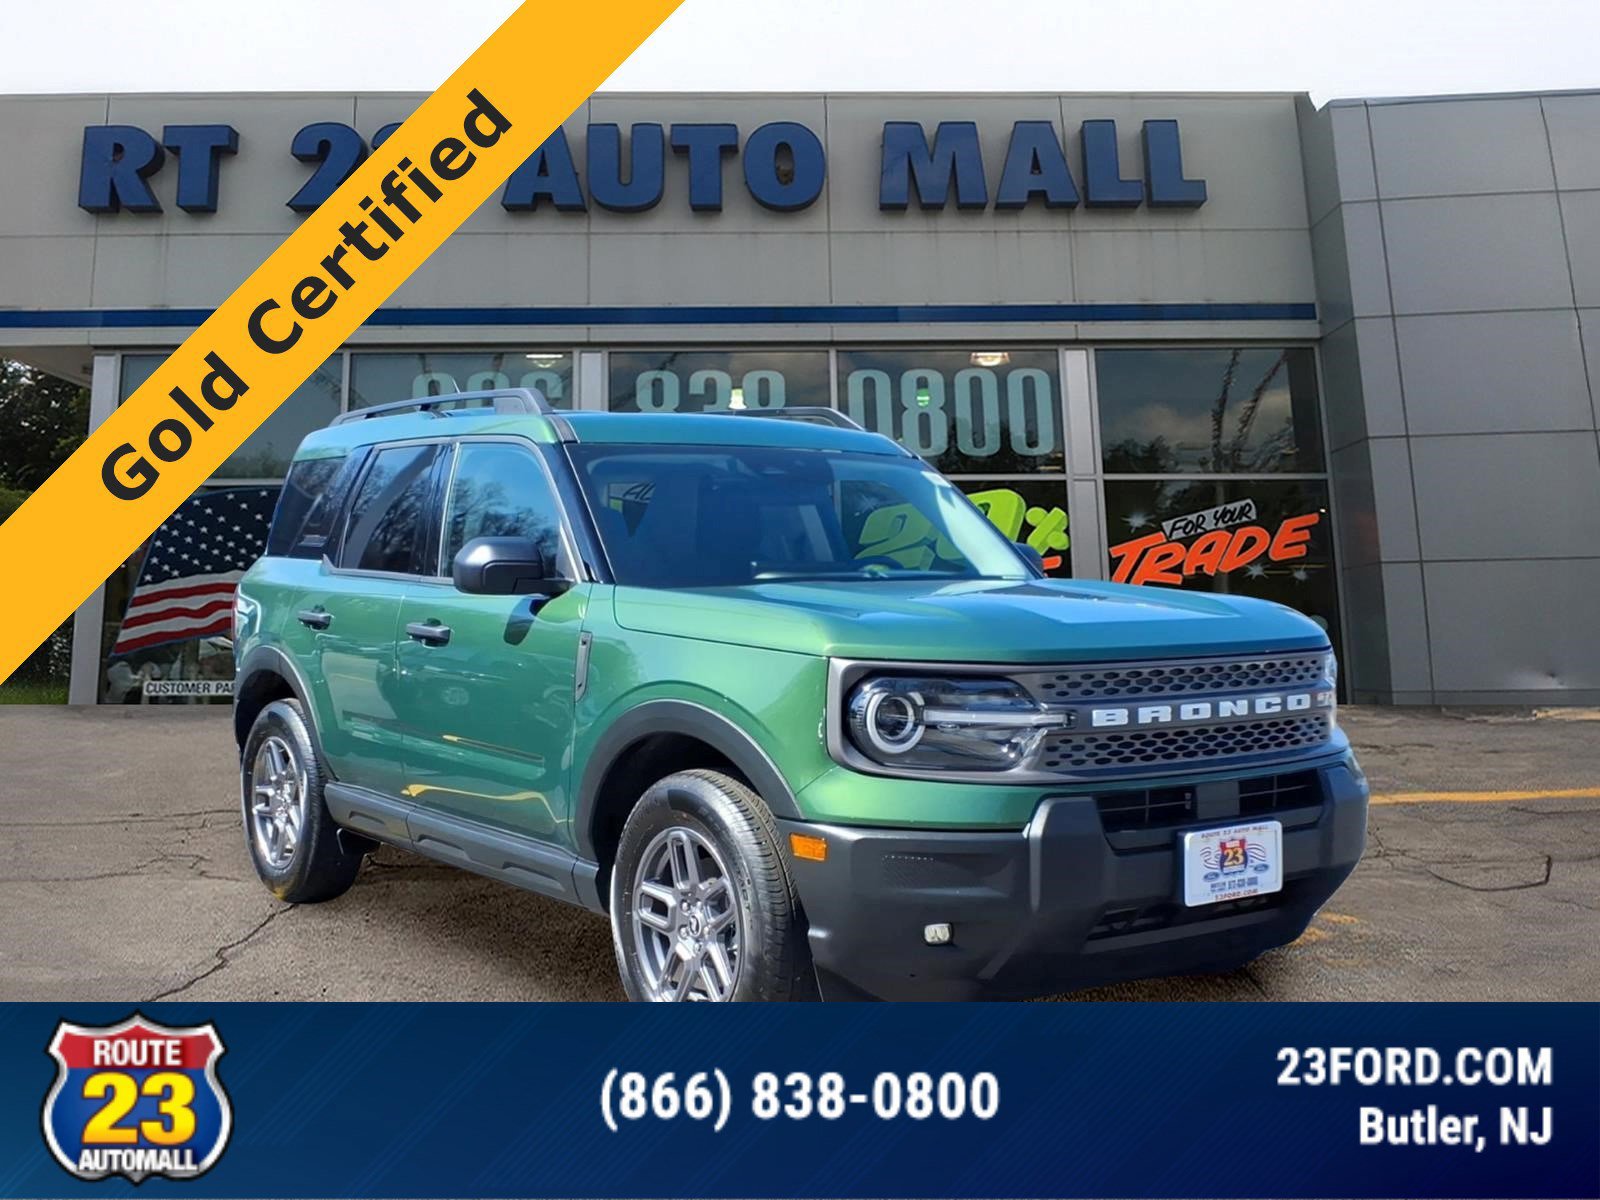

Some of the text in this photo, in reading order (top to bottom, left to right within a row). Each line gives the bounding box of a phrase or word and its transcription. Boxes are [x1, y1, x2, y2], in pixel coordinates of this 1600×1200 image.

[78, 119, 1207, 214] RT 2 AUTO MALL
[847, 368, 1054, 457] 0800
[1168, 502, 1252, 538] FOR YOUR
[1109, 512, 1320, 586] TRADE
[145, 682, 211, 694] CUSTOMER
[1092, 694, 1311, 727] BRONCO
[1223, 847, 1245, 867] 23
